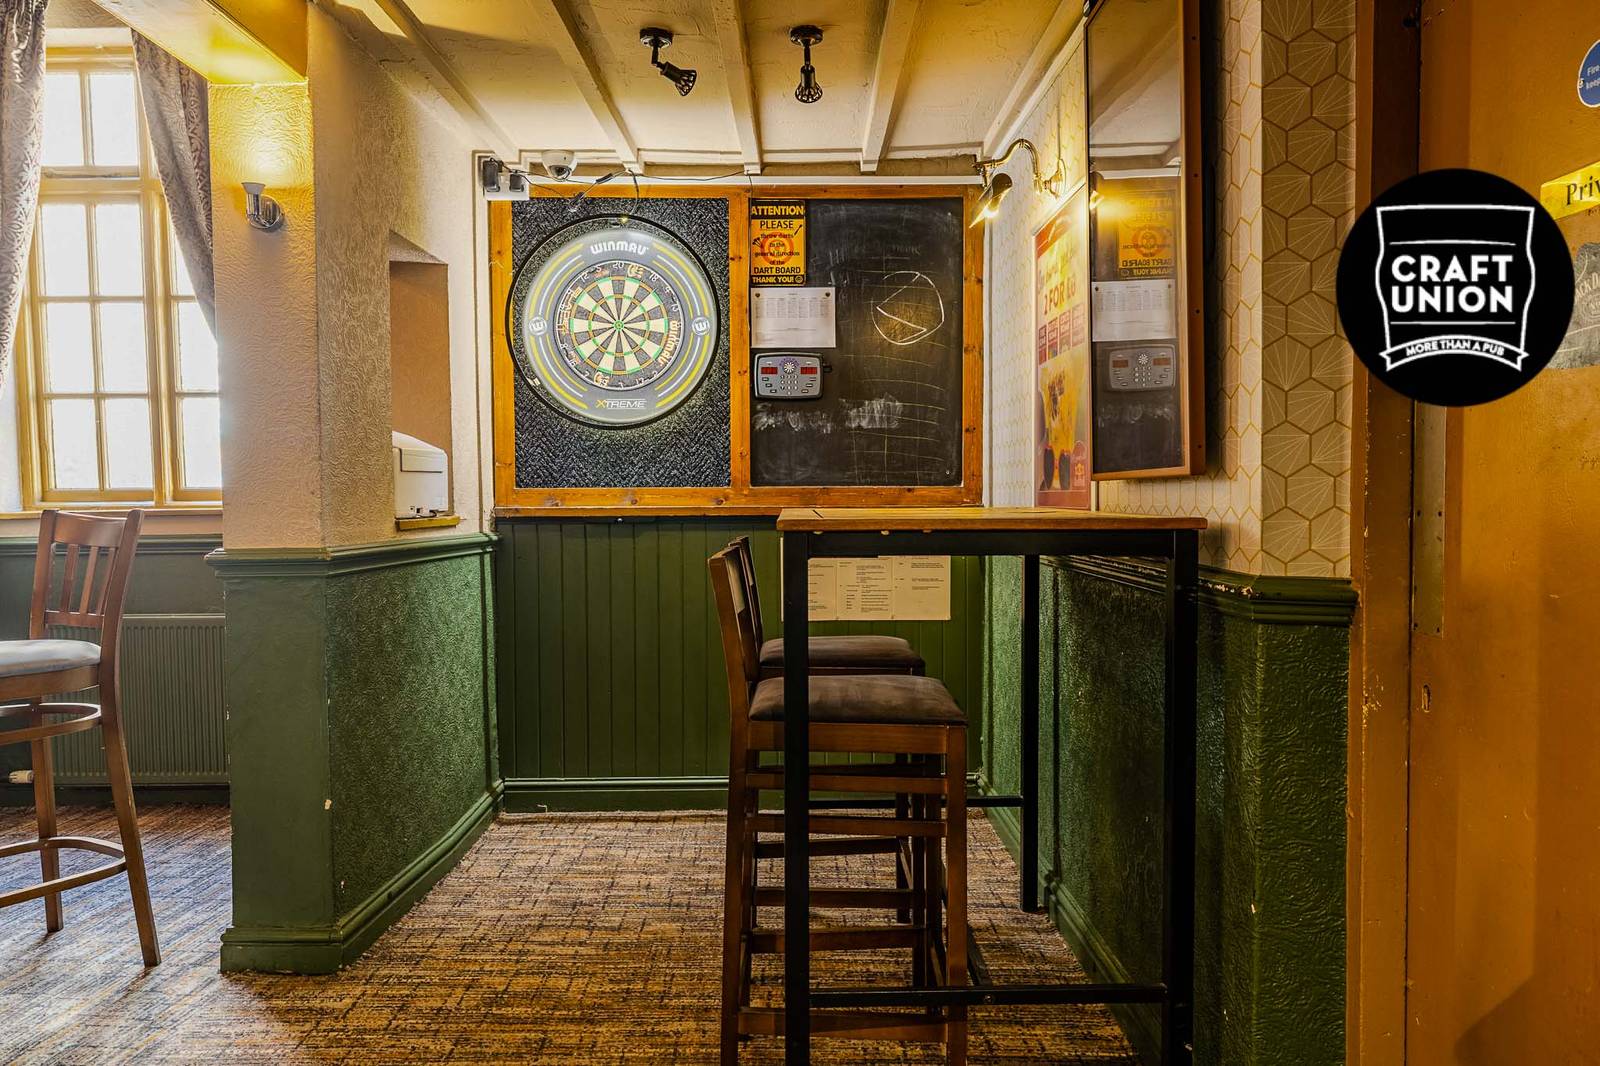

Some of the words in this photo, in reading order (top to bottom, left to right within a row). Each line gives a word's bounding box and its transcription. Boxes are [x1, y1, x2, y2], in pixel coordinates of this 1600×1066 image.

[751, 205, 804, 216] ATTENTION
[759, 220, 794, 229] PLEASE
[590, 240, 648, 256] WINMAU
[1048, 281, 1065, 311] FOR
[596, 399, 648, 410] XTREME
